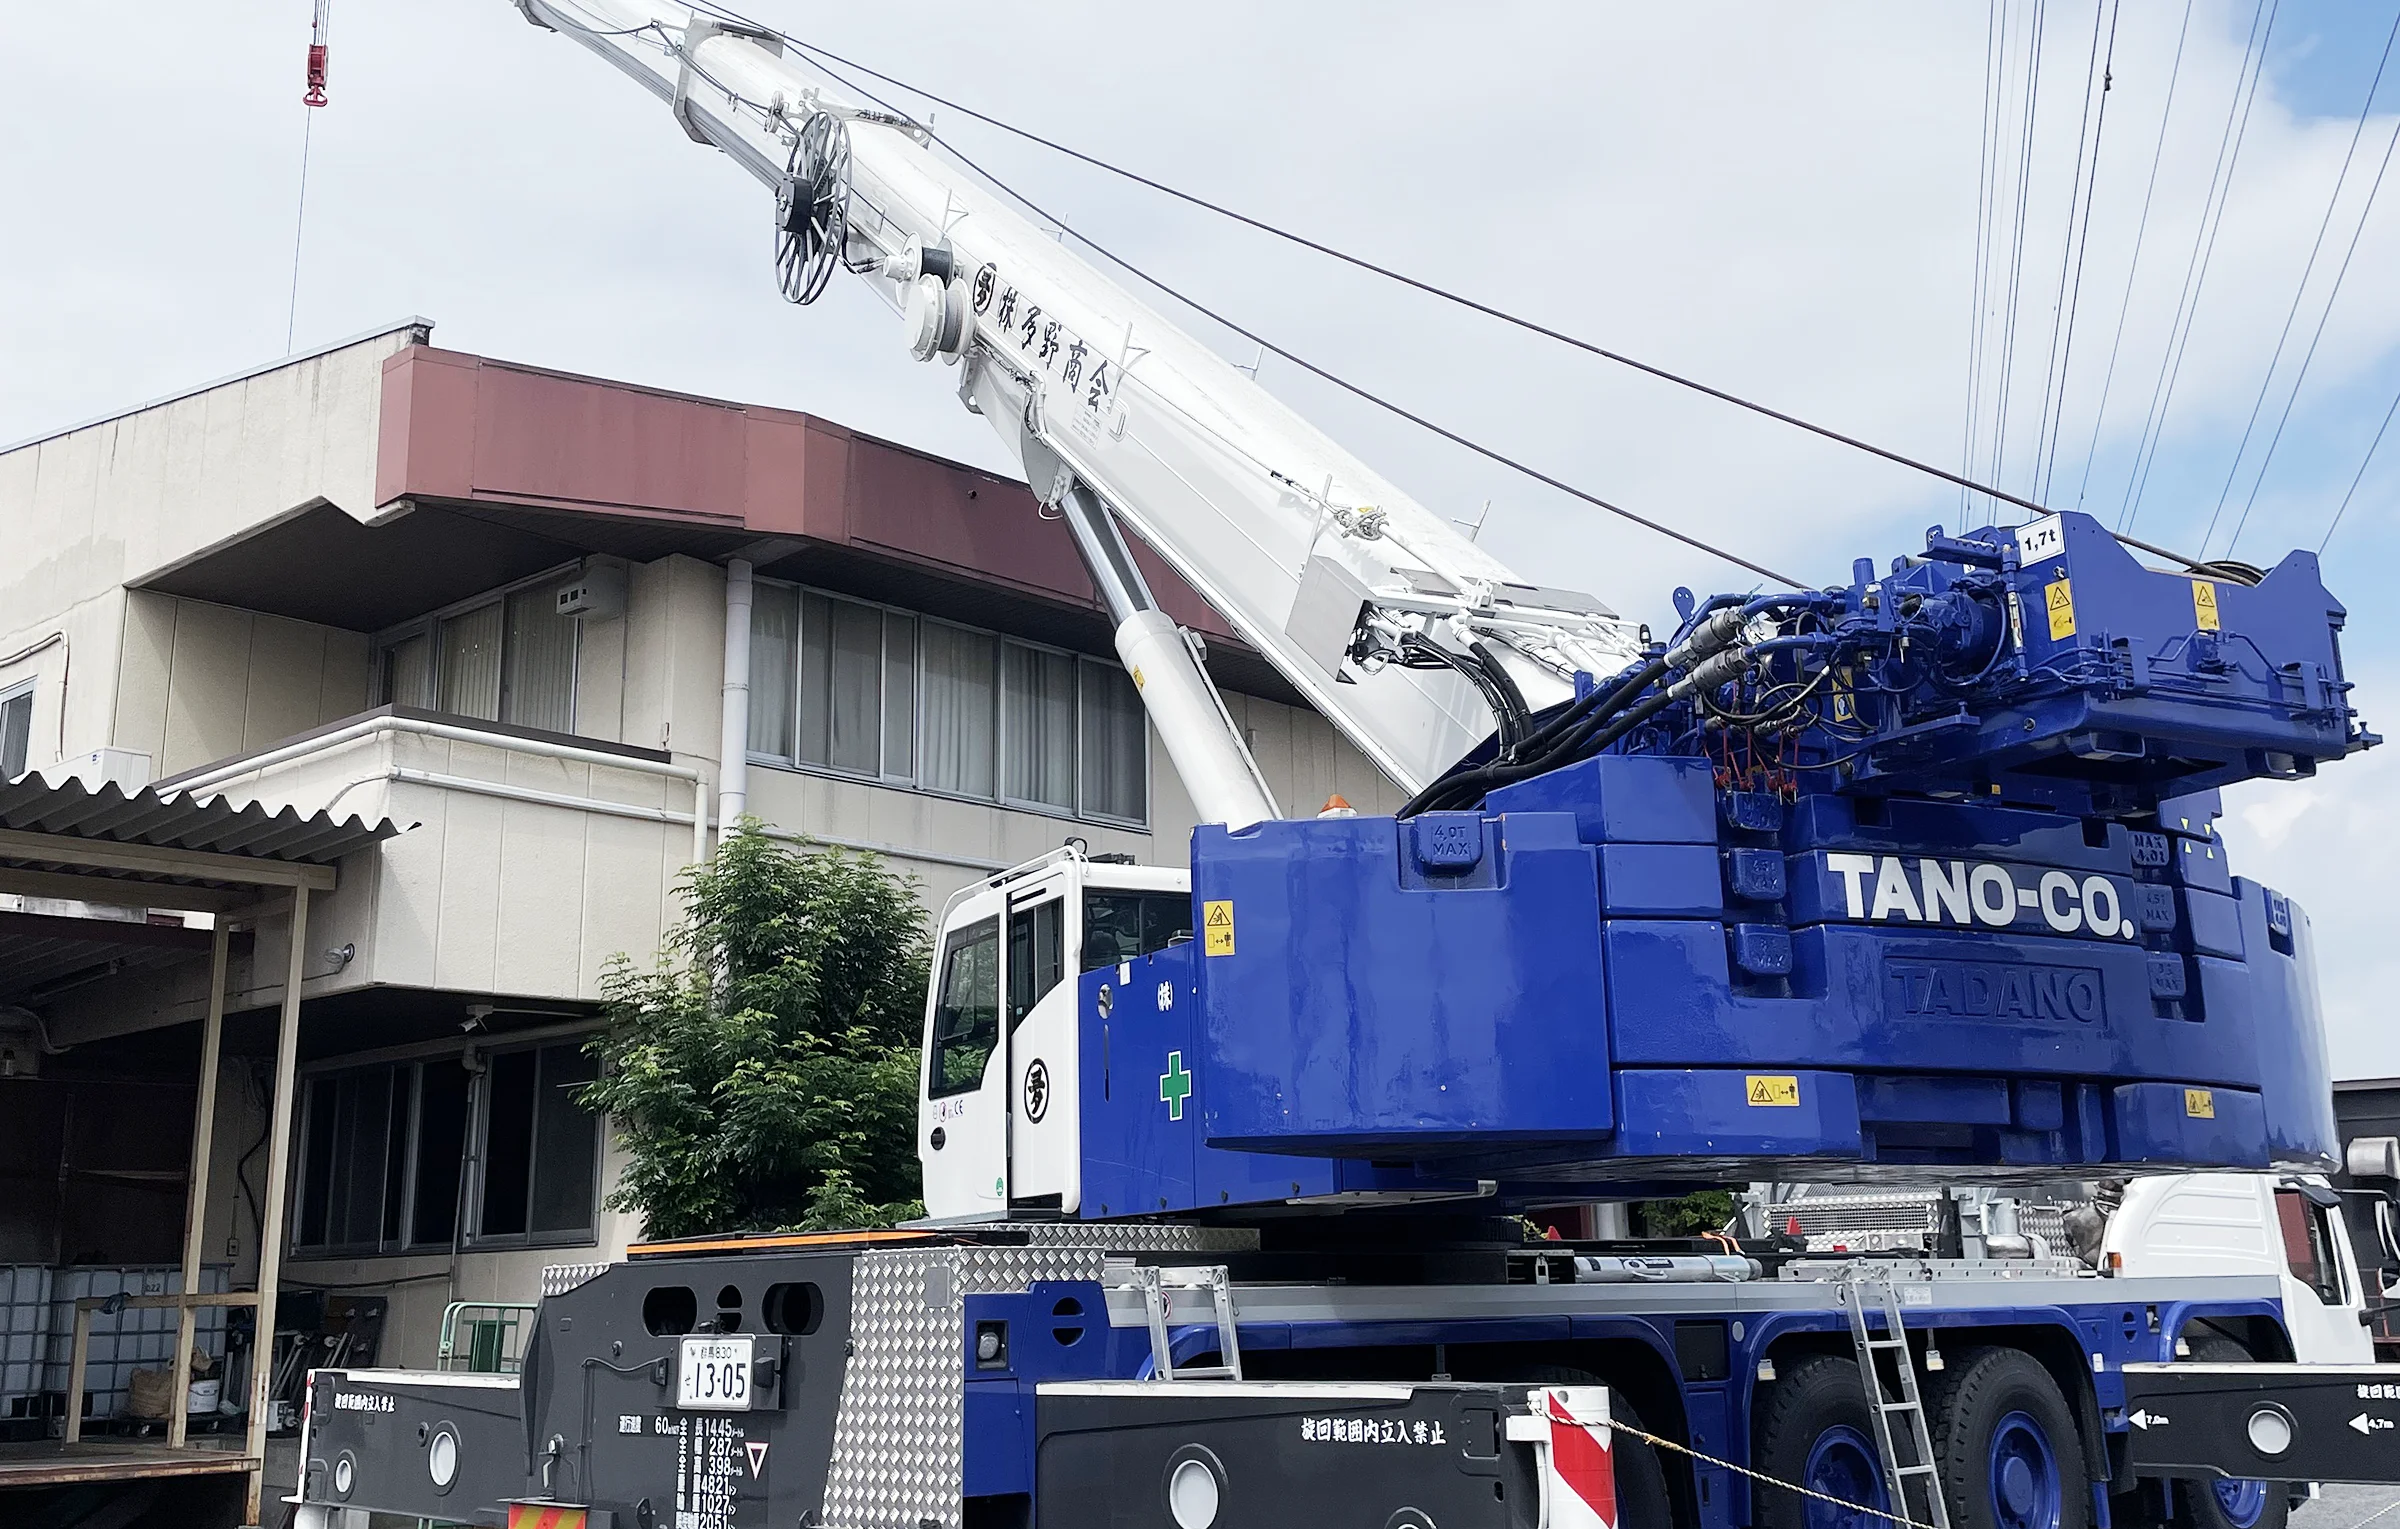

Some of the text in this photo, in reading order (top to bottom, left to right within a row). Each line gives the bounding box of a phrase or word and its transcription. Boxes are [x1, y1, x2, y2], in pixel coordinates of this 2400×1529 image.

[1432, 842, 1469, 855] MAX
[1826, 852, 2136, 940] TANO-CO.
[1890, 965, 2101, 1024] TADANO
[1301, 1417, 1447, 1446] 旋回範囲内立入禁止
